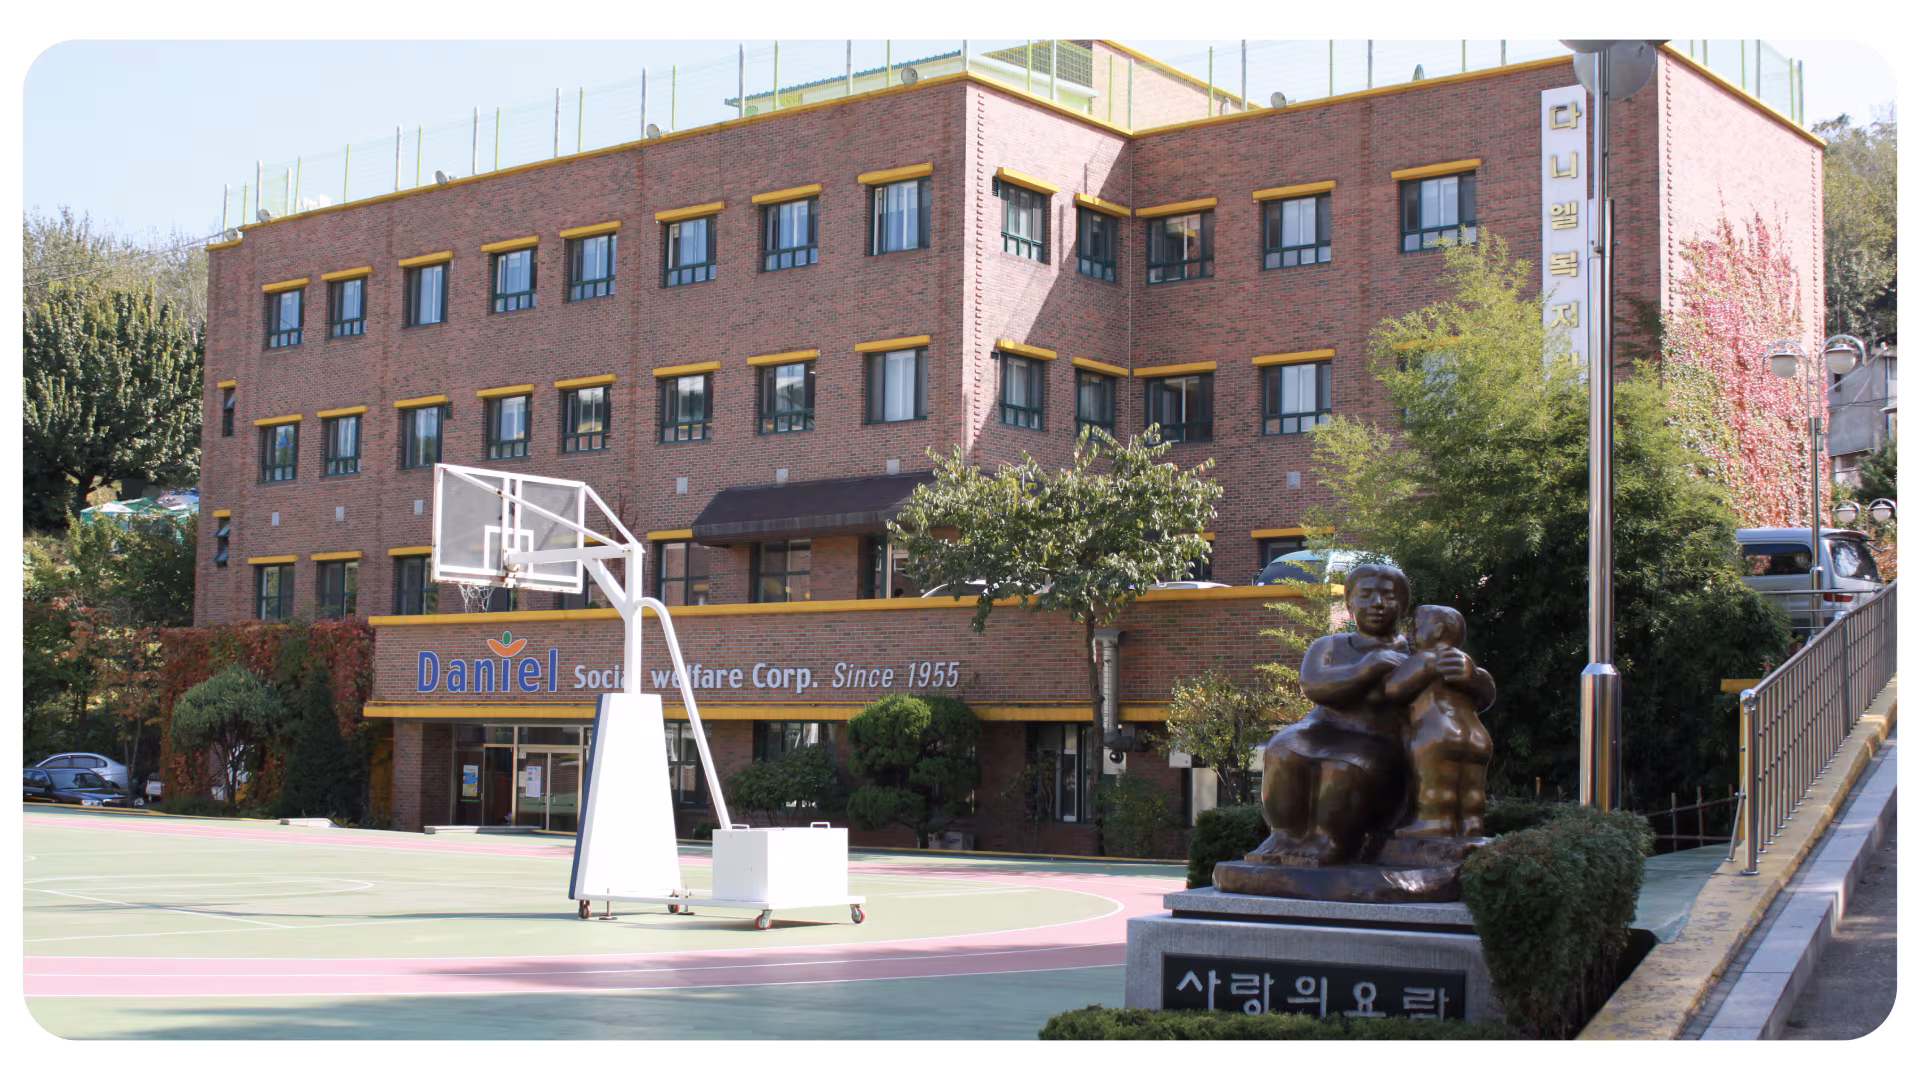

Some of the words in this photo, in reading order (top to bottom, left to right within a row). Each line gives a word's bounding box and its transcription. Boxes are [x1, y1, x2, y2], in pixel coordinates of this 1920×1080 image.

[417, 648, 558, 692] Daniel
[574, 664, 625, 689] Soci
[752, 663, 818, 693] Corp.
[832, 662, 894, 688] Since
[908, 661, 960, 688] 1955
